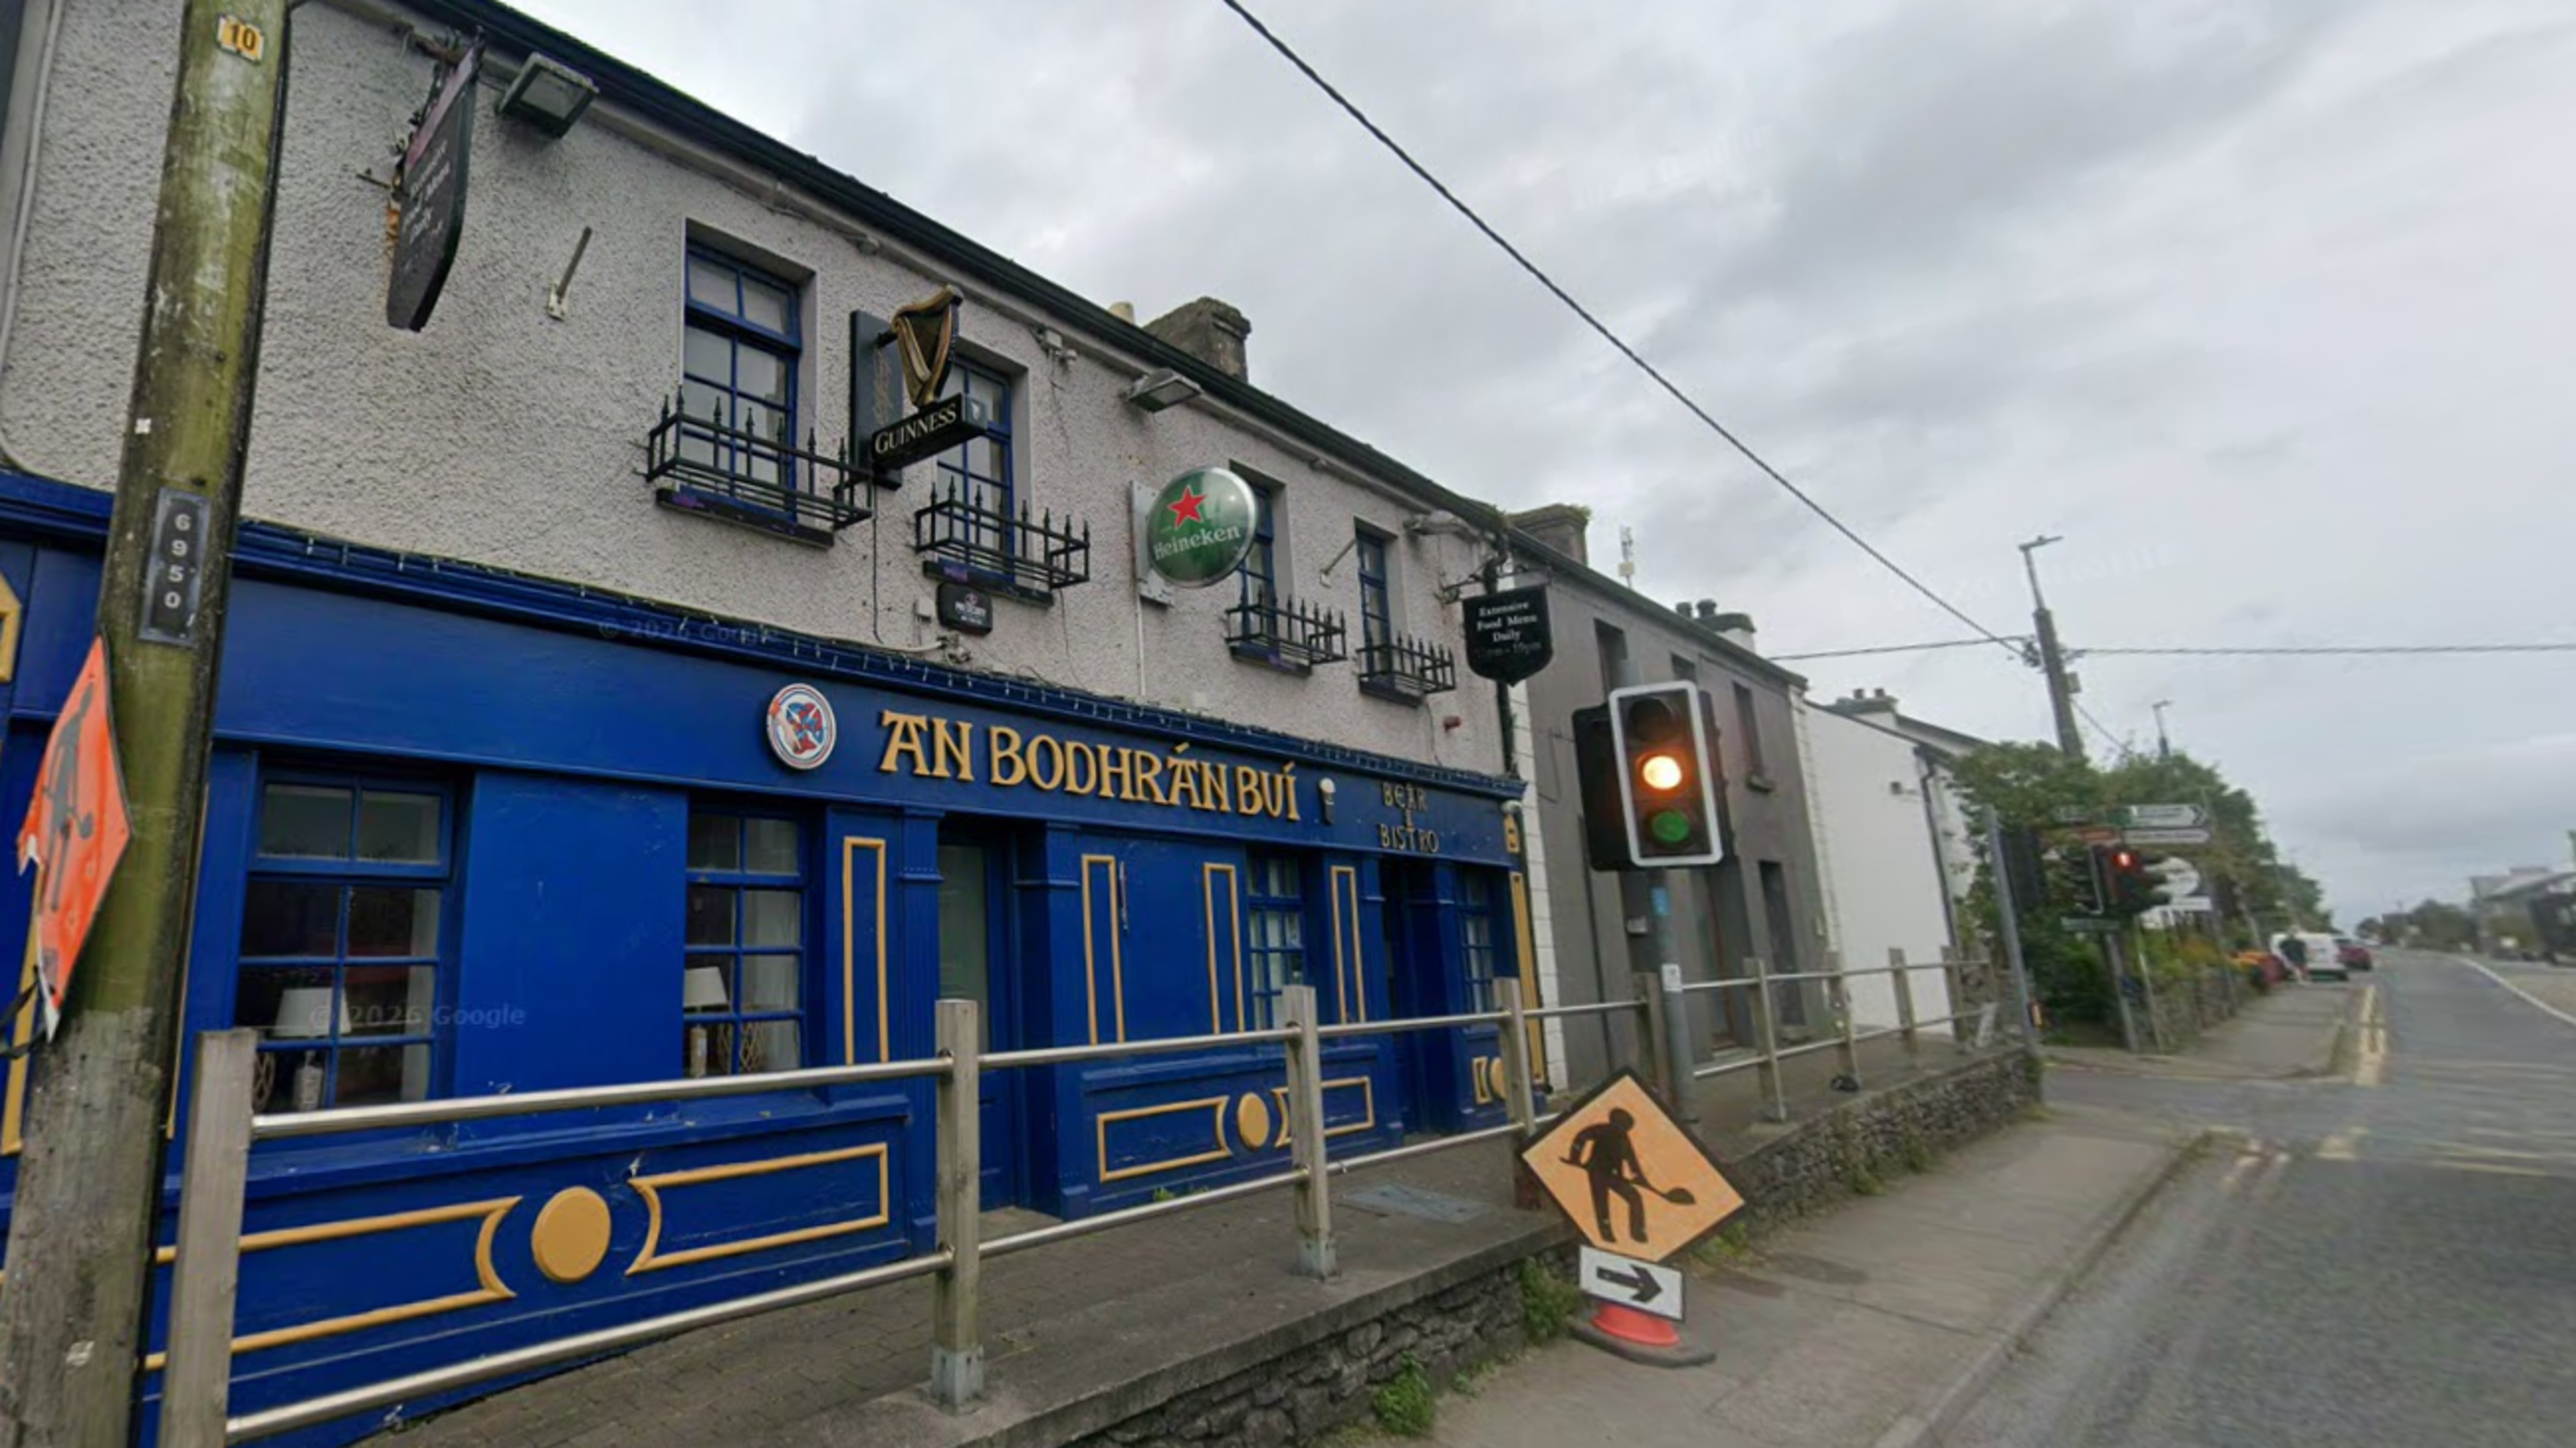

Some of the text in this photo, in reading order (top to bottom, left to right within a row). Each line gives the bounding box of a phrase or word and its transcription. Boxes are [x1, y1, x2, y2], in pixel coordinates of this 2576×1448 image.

[231, 25, 257, 51] 10
[874, 402, 957, 454] GUINNESS
[1152, 525, 1241, 561] Heineken
[1477, 614, 1538, 630] Food Menu
[1493, 628, 1521, 643] Daily
[879, 709, 1301, 821] AN BODHRÁN BUÍ
[1380, 823, 1439, 853] BISTRO
